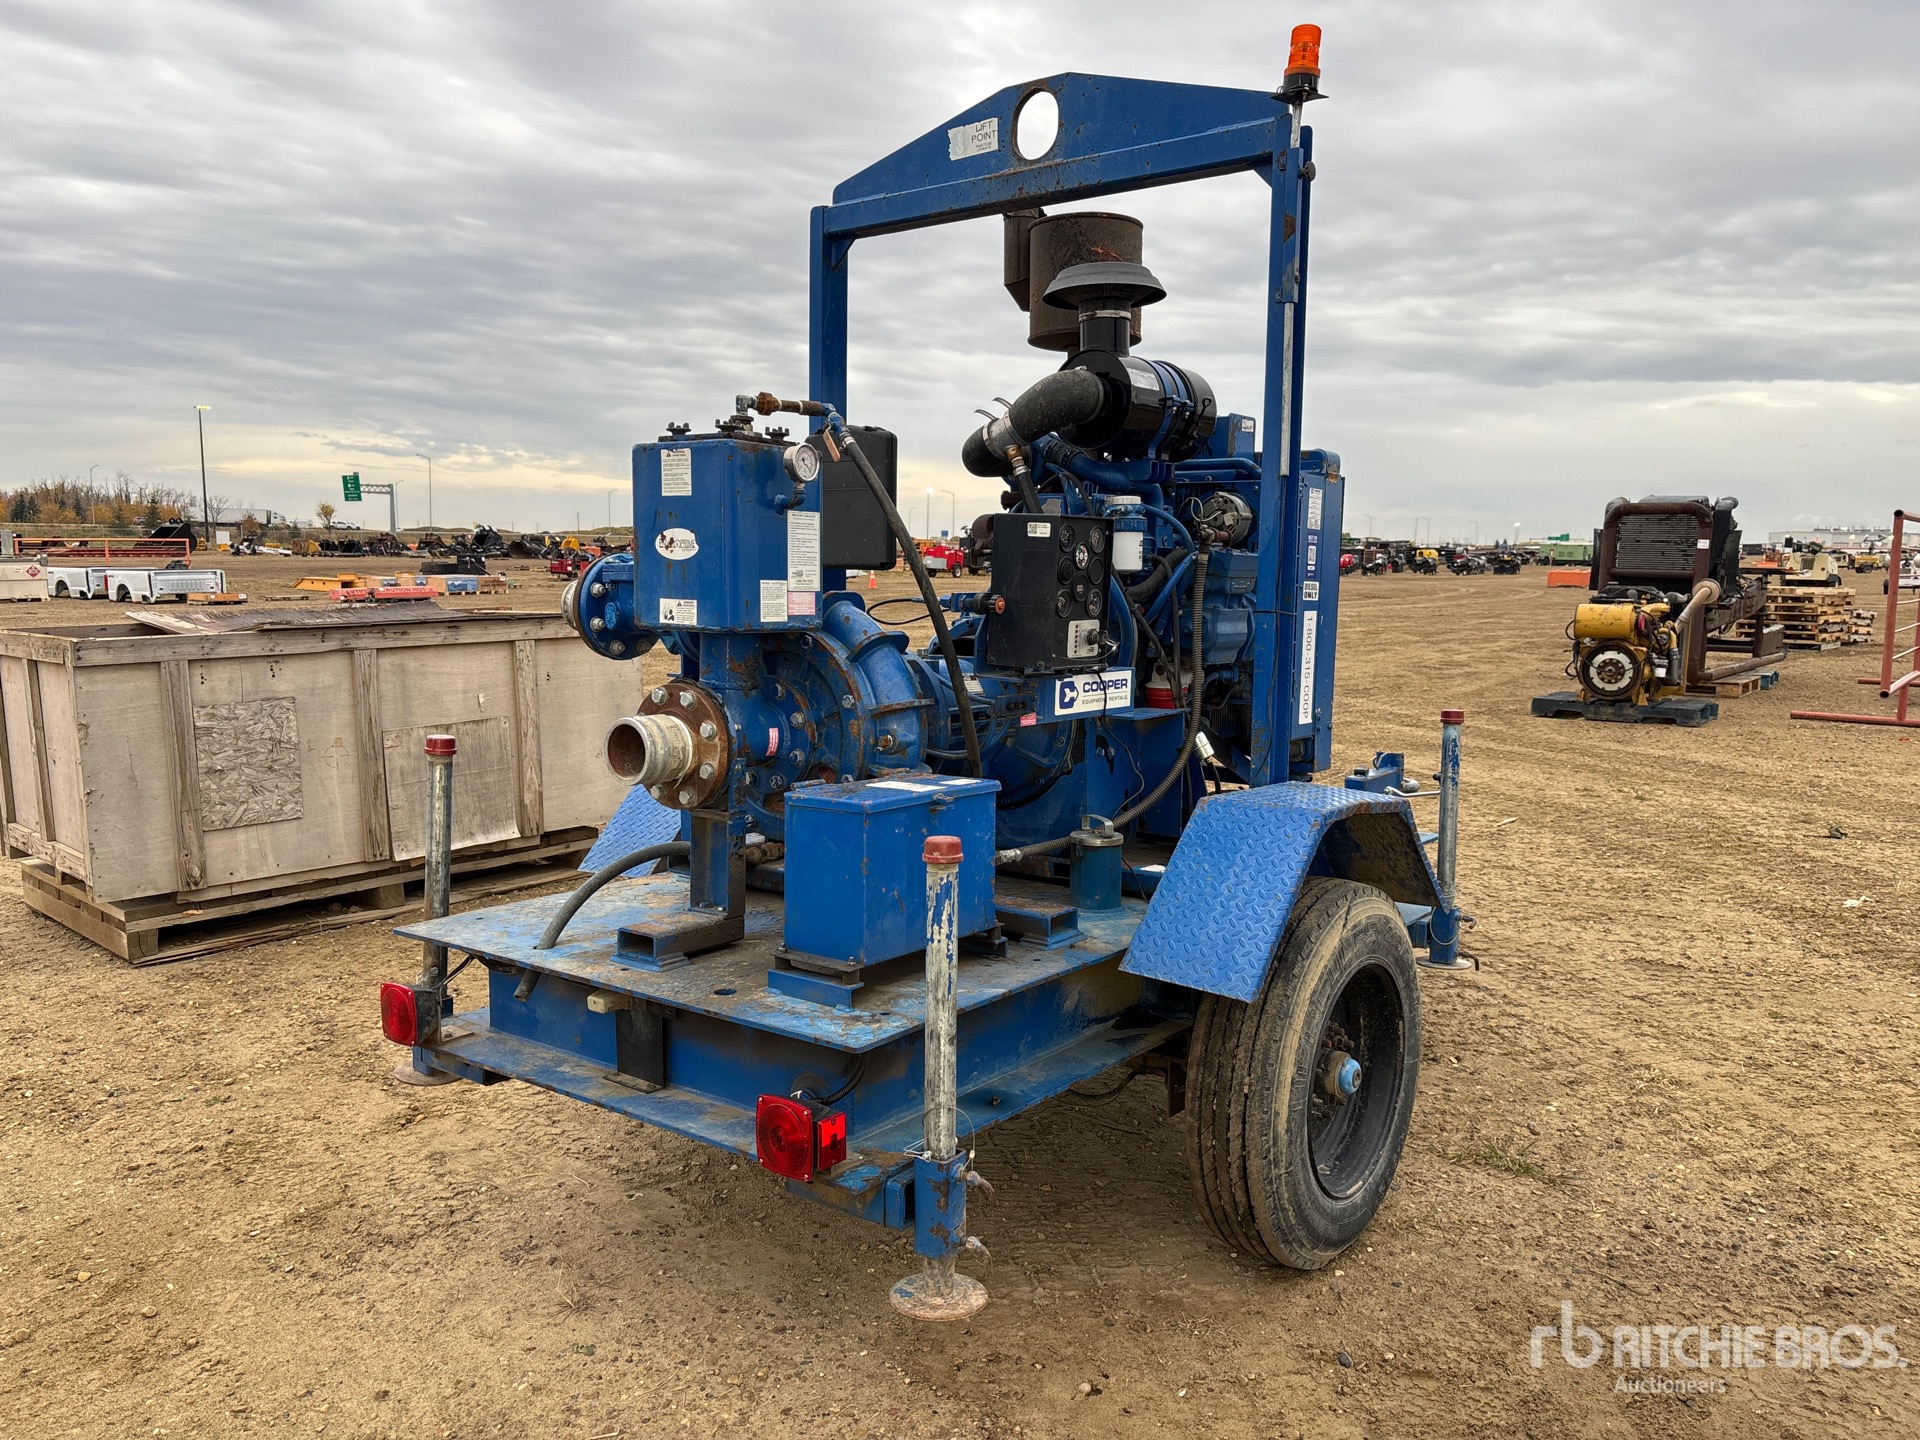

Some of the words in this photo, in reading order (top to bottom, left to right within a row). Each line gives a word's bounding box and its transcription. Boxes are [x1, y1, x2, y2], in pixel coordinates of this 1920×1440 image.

[975, 121, 993, 133] LIFT
[971, 130, 996, 143] POINT
[1304, 582, 1318, 591] DIESEL
[1303, 591, 1318, 599] ONLY
[1303, 616, 1313, 719] 1-800-315-COOP
[1082, 678, 1128, 694] COOPER
[1081, 697, 1105, 705] EQUIPMEN
[1108, 694, 1128, 702] RENTALS
